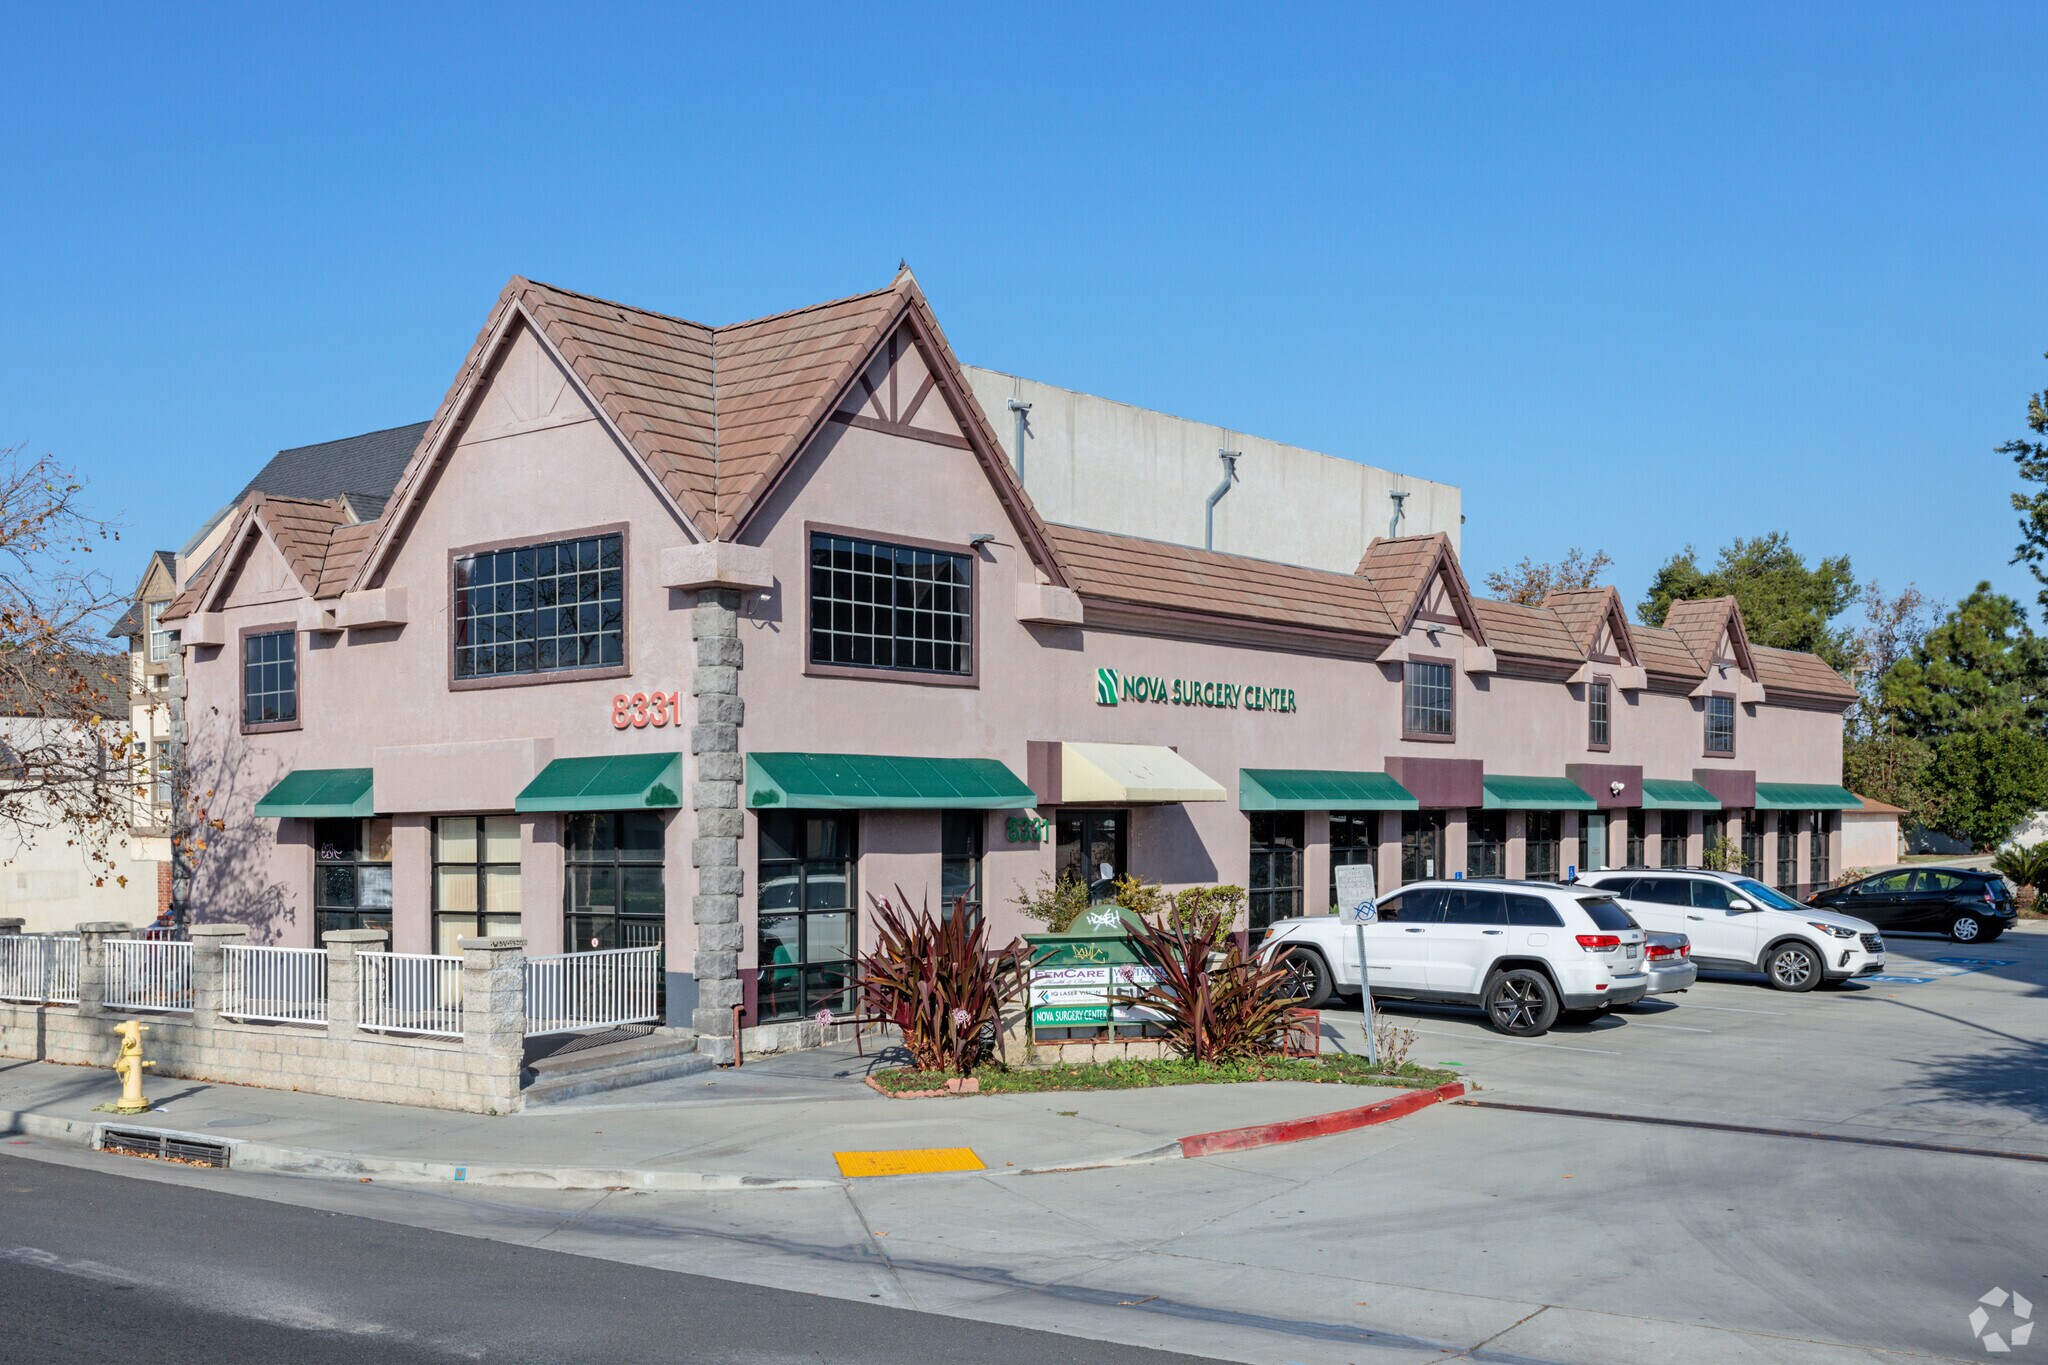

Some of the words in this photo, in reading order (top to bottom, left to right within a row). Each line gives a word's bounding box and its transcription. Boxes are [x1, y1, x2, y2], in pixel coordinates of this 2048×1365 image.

[1121, 675, 1168, 702] NOVA
[1171, 679, 1241, 707] SURGERY
[1243, 685, 1296, 711] CENTER
[612, 691, 681, 730] 8331
[1007, 817, 1049, 844] 8331
[1036, 1011, 1054, 1021] NOVA
[1055, 1010, 1083, 1021] SURGERY
[1084, 1009, 1108, 1020] CENTER
